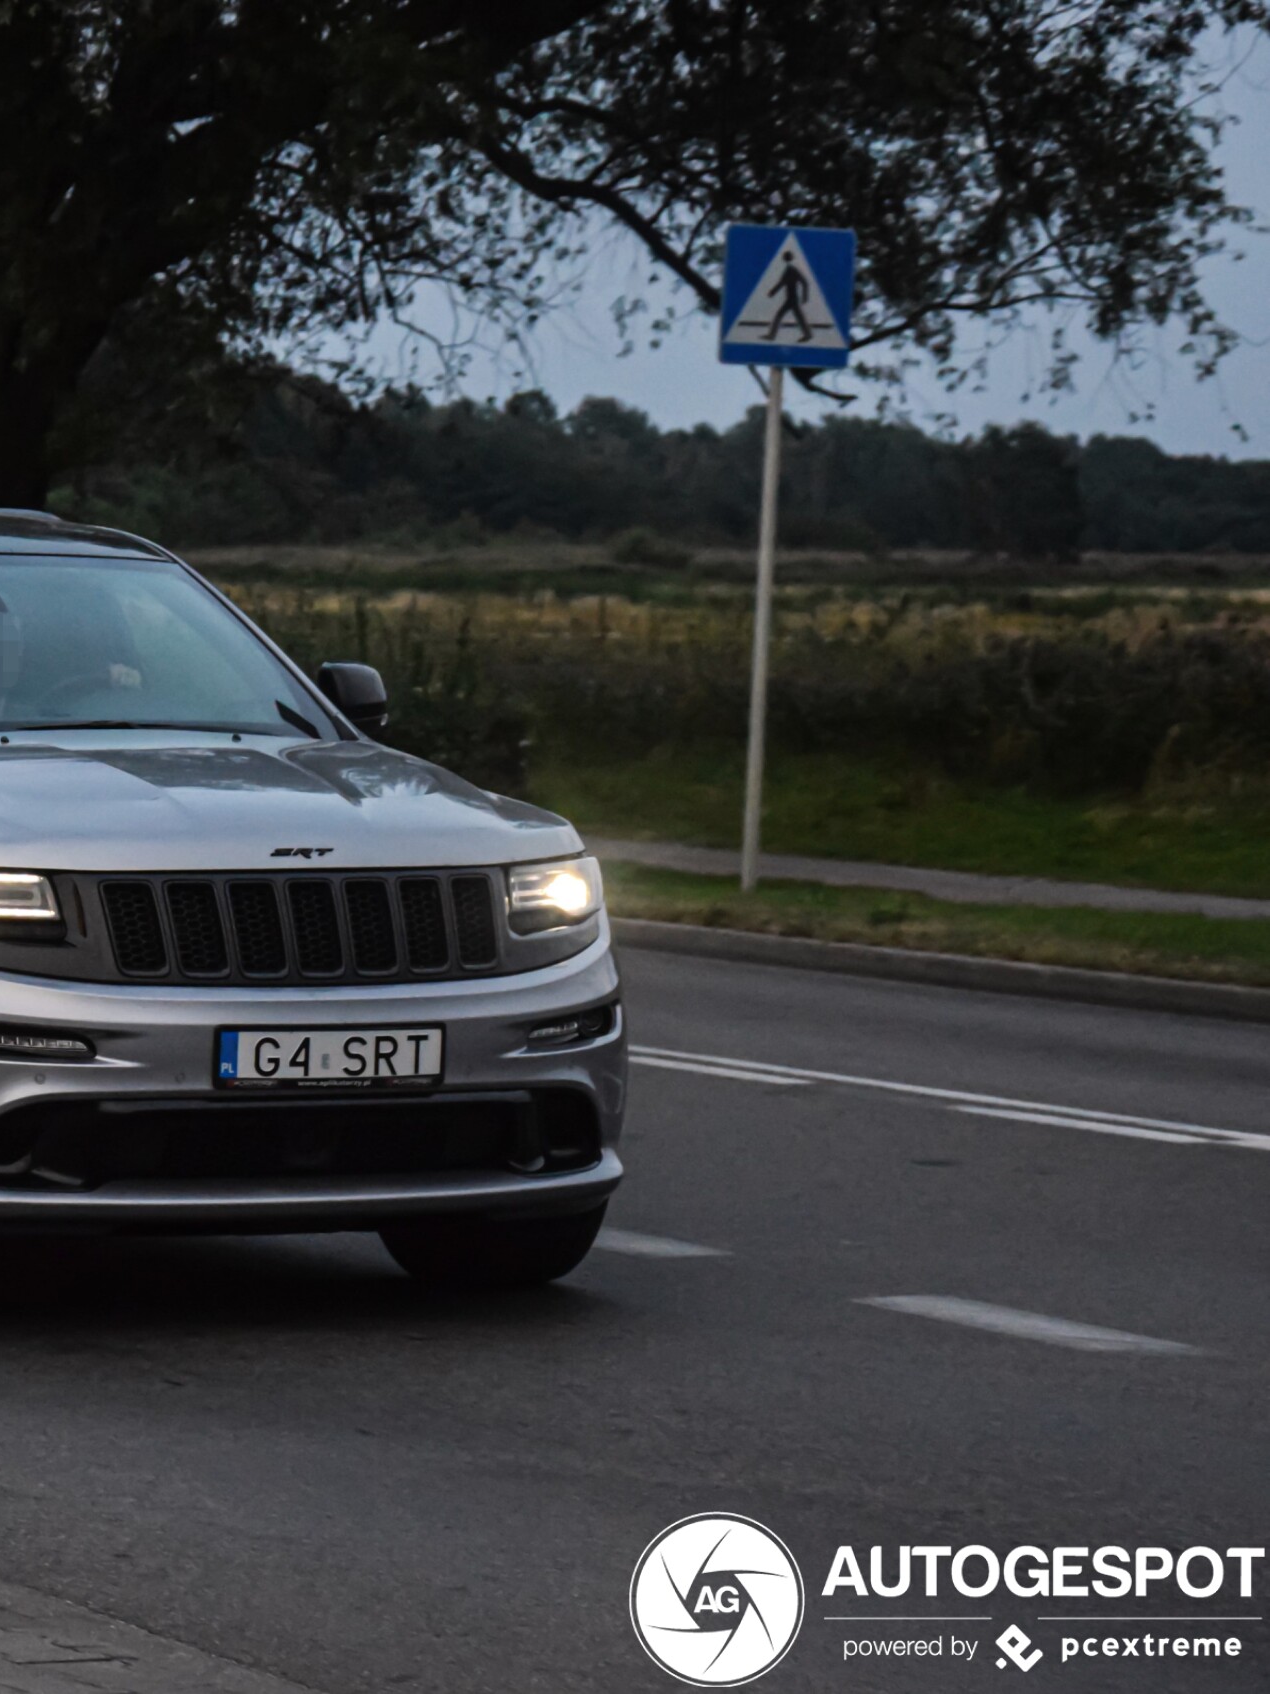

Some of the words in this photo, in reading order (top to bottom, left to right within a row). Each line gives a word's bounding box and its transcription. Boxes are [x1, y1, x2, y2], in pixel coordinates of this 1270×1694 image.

[270, 848, 334, 859] SRT
[254, 1037, 311, 1077] G4
[342, 1035, 429, 1076] SRT
[221, 1062, 235, 1074] PL
